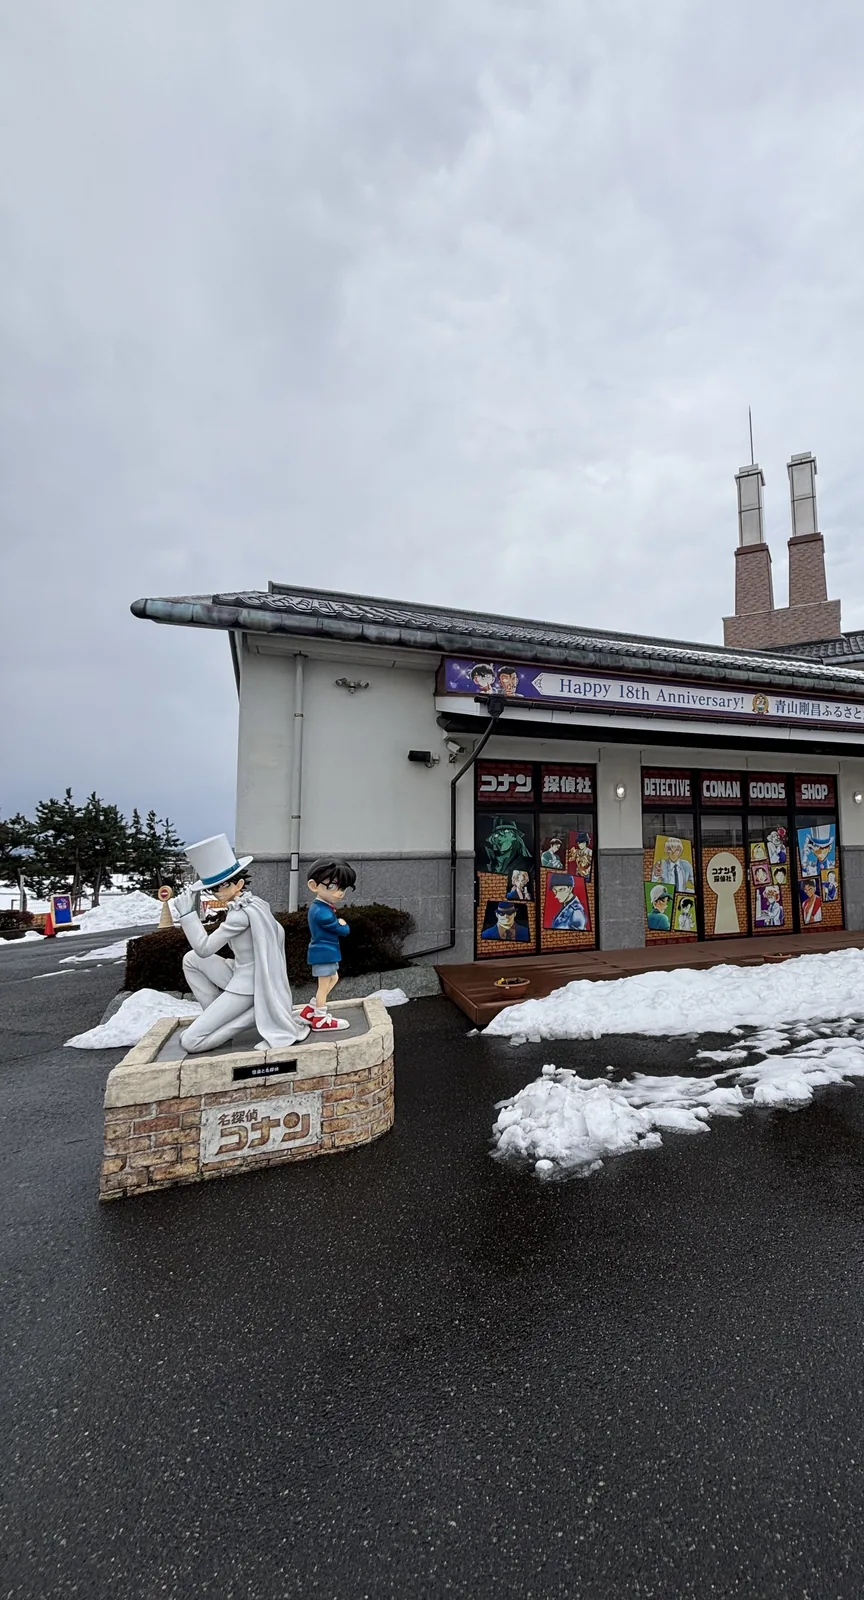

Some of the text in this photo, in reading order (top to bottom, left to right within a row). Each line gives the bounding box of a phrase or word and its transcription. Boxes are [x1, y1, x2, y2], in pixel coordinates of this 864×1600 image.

[559, 678, 744, 710] Happy 18th Anniversary!
[775, 699, 864, 720] 青山剛昌ふるさと
[479, 773, 592, 794] コナン 探偵社
[644, 777, 828, 801] DETECTIVE CONAN GOODS SHOP
[712, 866, 730, 875] コナン
[217, 1109, 258, 1126] 名探偵
[215, 1112, 311, 1156] コナン
